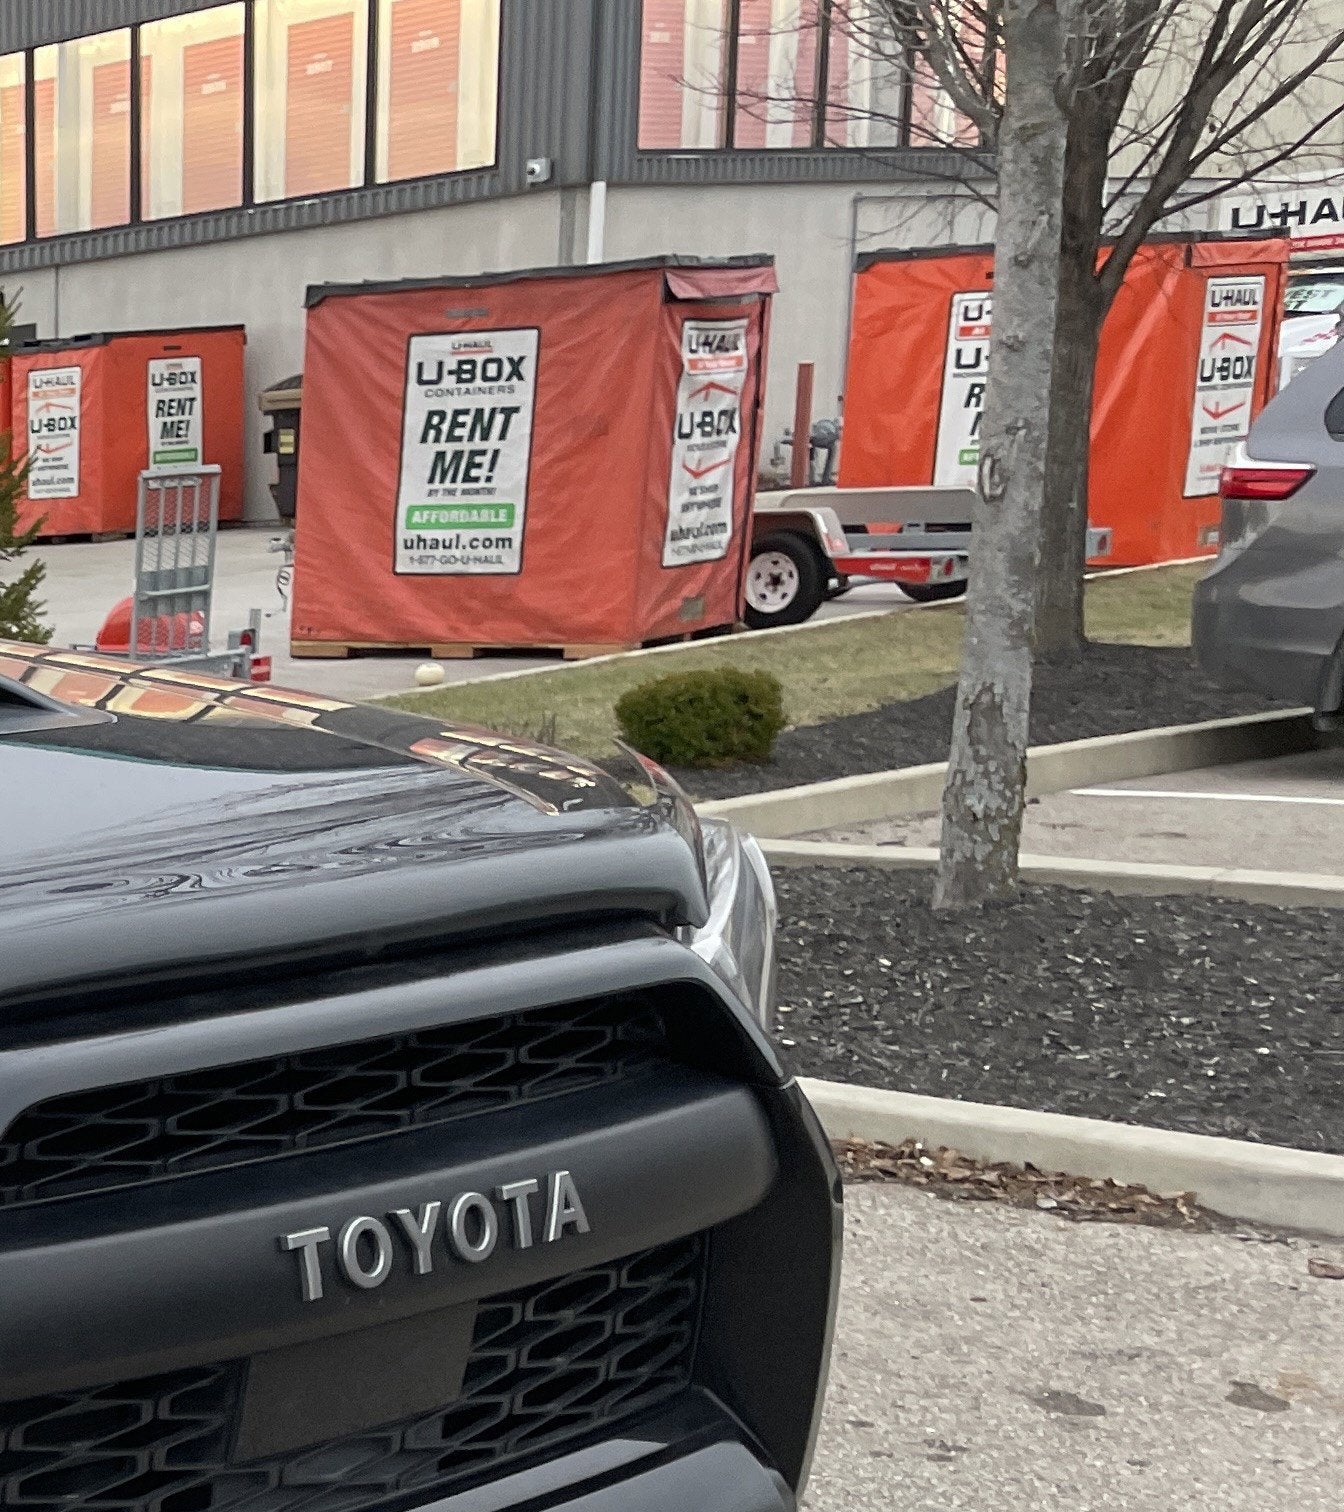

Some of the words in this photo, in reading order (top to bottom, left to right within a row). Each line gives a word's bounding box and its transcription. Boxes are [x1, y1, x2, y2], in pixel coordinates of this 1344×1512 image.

[1232, 198, 1344, 230] U-HA
[151, 371, 197, 387] U-BOX
[416, 356, 526, 385] U-BOX
[1200, 356, 1255, 382] U-BOX
[424, 385, 516, 398] CONTAINERS
[155, 397, 196, 418] RENT
[30, 415, 77, 433] U-BOX
[160, 419, 190, 439] ME!
[420, 405, 521, 444] RENT
[678, 407, 738, 440] U-BOX
[427, 448, 501, 484] ME!
[412, 508, 508, 524] AFFORDABLE
[403, 533, 513, 551] uhaul.com
[279, 1169, 591, 1301] TOYOTA
